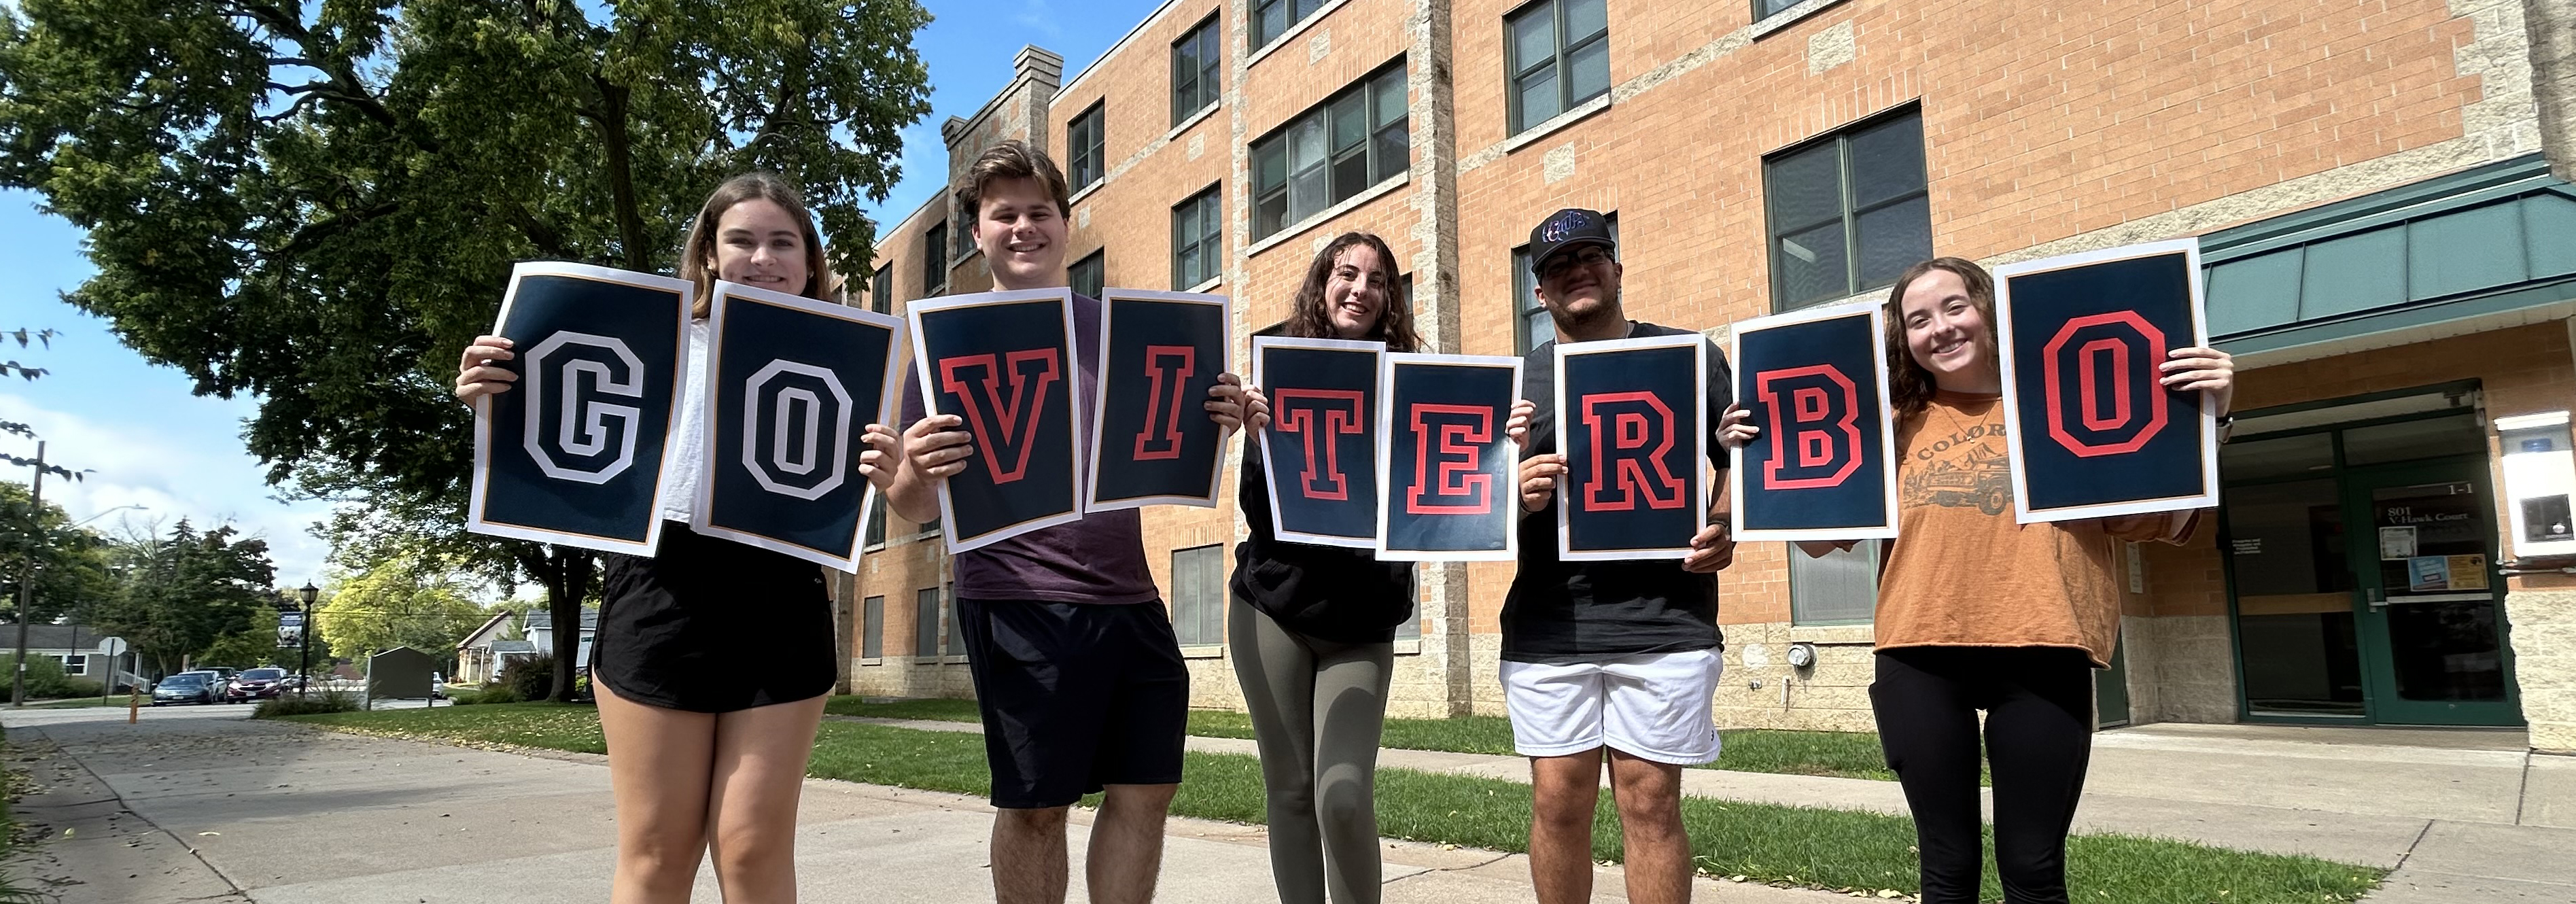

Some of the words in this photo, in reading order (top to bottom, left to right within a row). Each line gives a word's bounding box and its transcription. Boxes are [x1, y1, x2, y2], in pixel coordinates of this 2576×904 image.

[2448, 483, 2473, 495] 1-1
[2388, 506, 2412, 517] 801
[2435, 512, 2469, 521] Court
